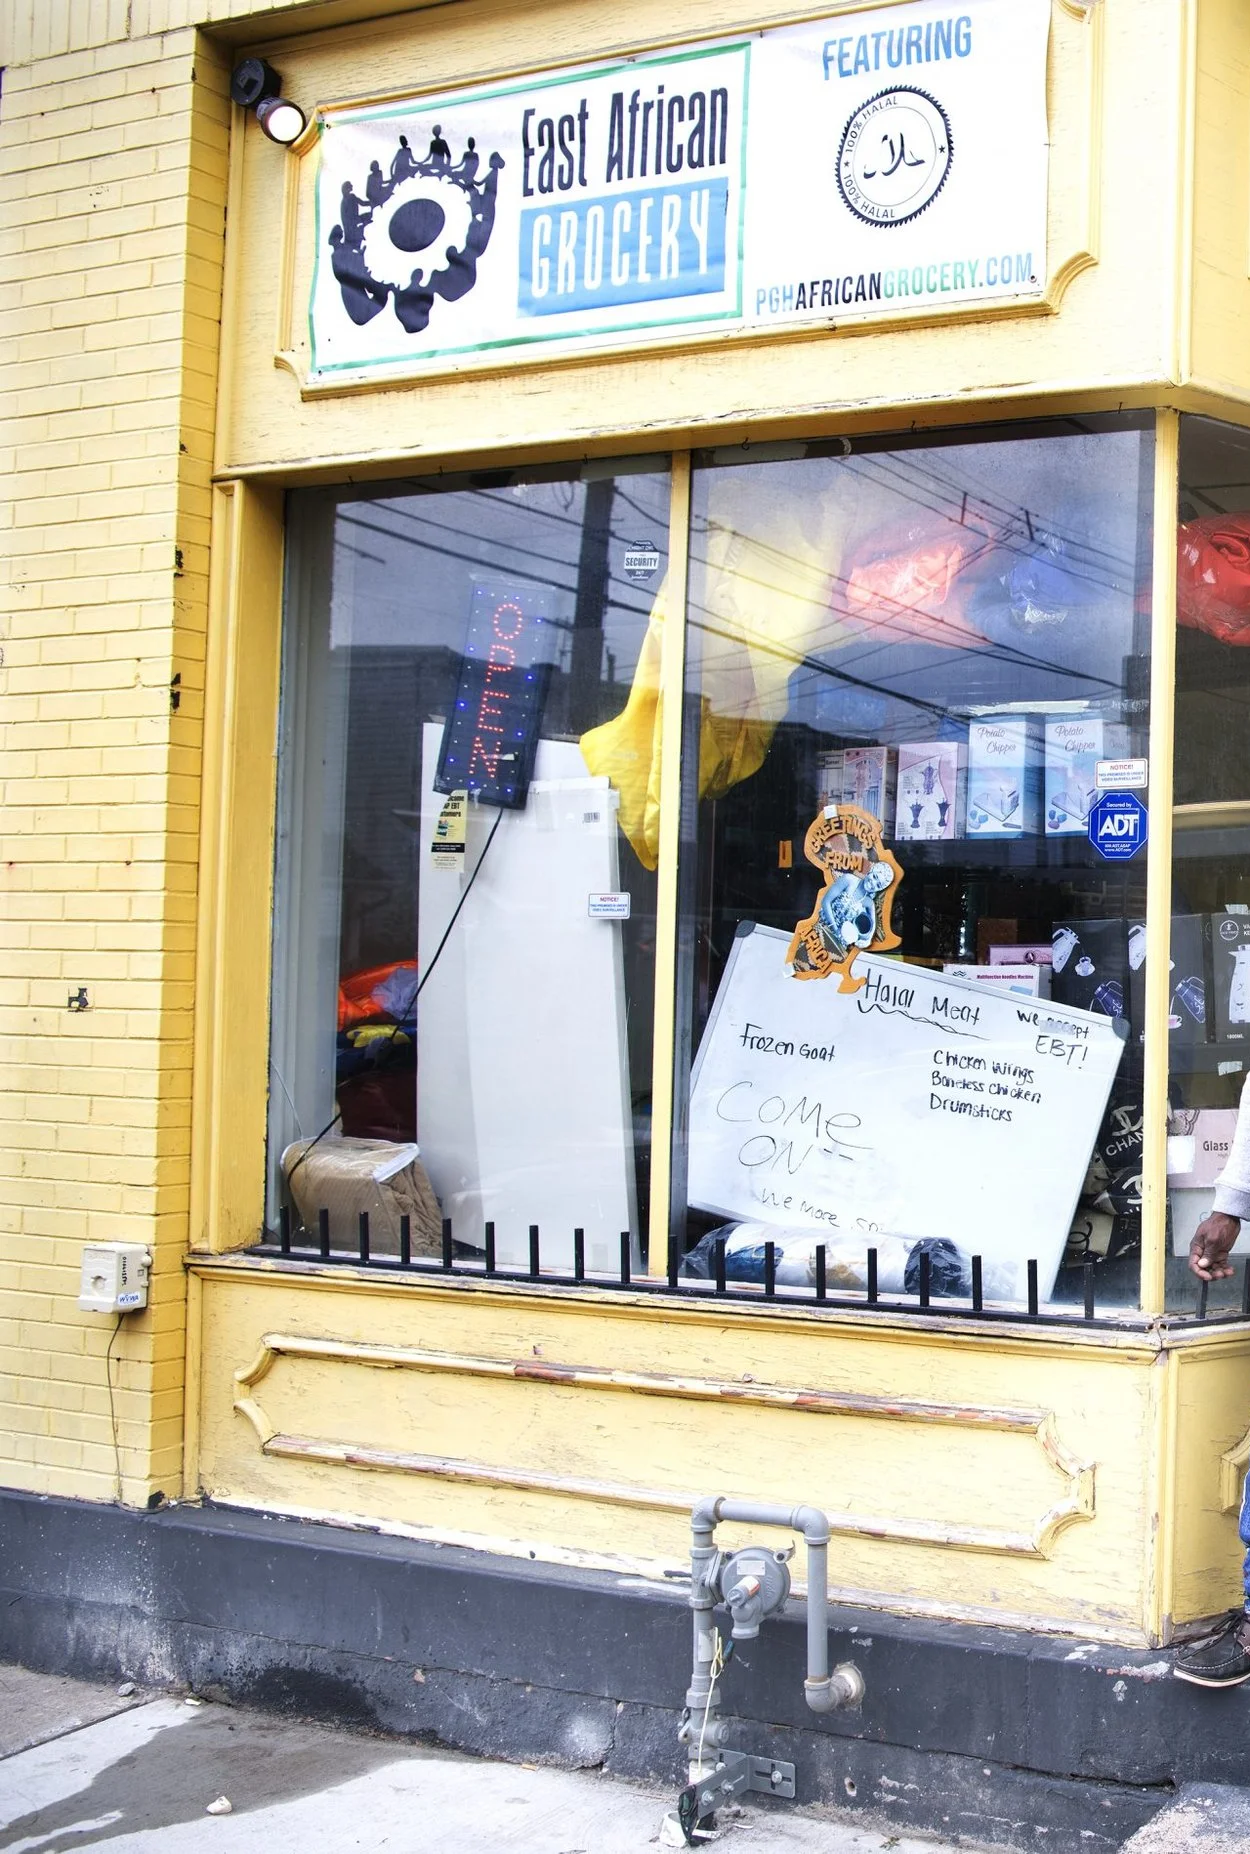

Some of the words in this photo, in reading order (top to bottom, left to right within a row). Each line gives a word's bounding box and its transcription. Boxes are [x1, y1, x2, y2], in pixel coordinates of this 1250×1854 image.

[822, 15, 972, 81] FEATURING
[522, 97, 589, 198] East
[606, 84, 729, 183] African
[845, 120, 863, 153] 100%
[861, 95, 898, 120] HALAL
[843, 174, 861, 205] 100%
[860, 202, 896, 219] HALAL
[531, 188, 710, 298] GROCERY
[625, 557, 657, 567] SECURITY
[468, 602, 523, 780] OPEN
[977, 726, 1006, 738] Potato
[986, 740, 1017, 755] Chipper
[1054, 725, 1084, 737] Potato
[1064, 739, 1096, 754] Chipper
[811, 815, 876, 853] GREETINGS
[1098, 814, 1139, 836] ADT
[824, 851, 864, 873] FROM
[799, 925, 834, 974] AFRICA
[865, 968, 915, 1009] Halal
[931, 996, 981, 1026] Meat
[738, 1023, 795, 1056] Frozen
[799, 1043, 836, 1062] Goat
[1035, 1034, 1089, 1070] EBT!
[930, 1092, 1014, 1122] Drumsticks
[1105, 1129, 1144, 1157] CHAN
[1202, 1140, 1229, 1152] Glass
